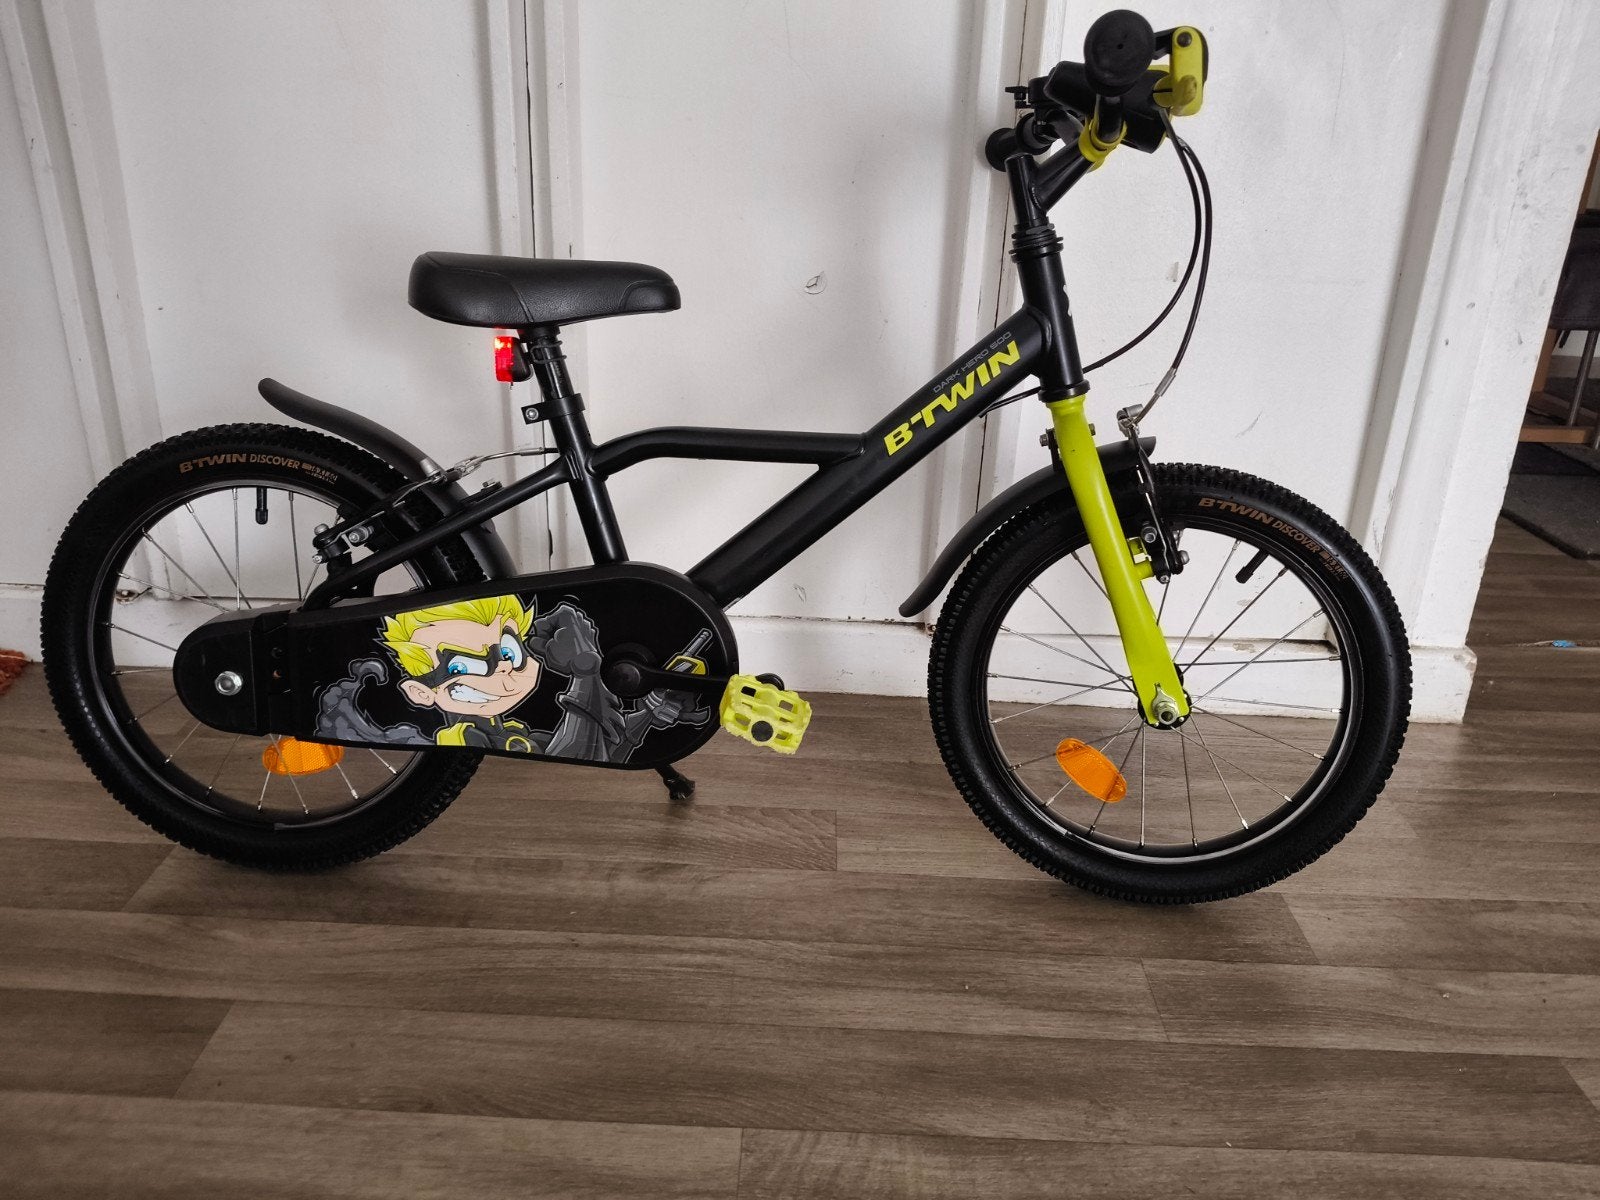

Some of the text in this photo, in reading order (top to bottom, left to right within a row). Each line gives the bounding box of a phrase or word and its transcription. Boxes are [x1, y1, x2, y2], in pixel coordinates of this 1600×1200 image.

[933, 331, 1012, 393] DARK HERO 500
[250, 453, 300, 470] DISCOVER
[1272, 520, 1321, 553] DISCOVER
